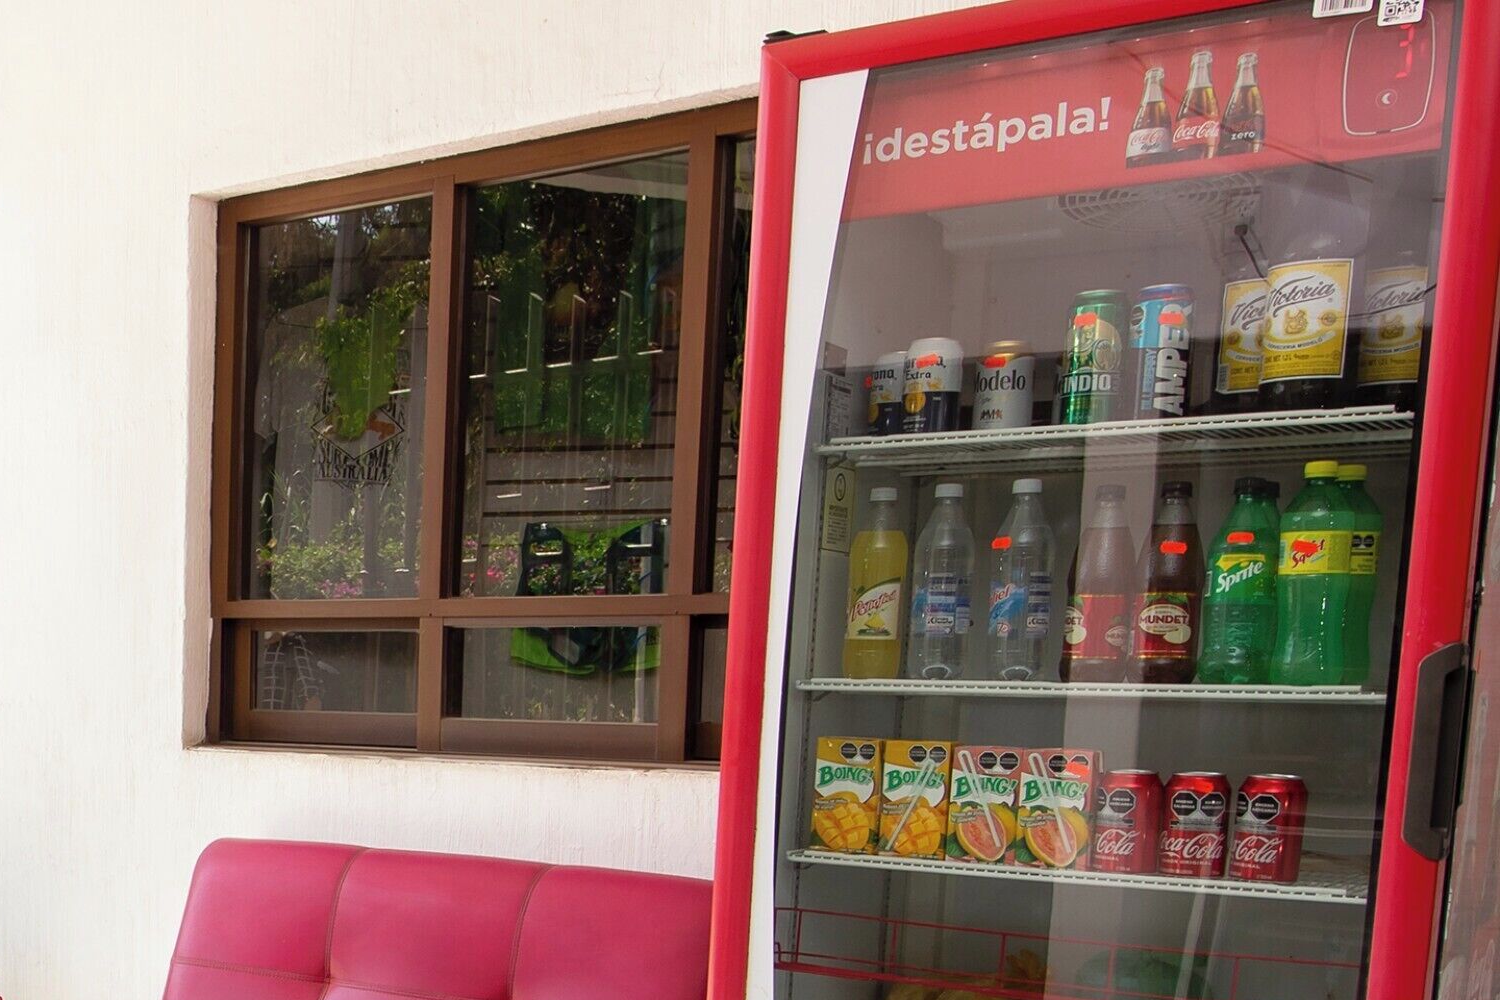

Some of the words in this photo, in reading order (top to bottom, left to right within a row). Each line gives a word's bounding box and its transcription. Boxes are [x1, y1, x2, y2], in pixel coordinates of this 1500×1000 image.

[863, 97, 1112, 165] ¡destápala!
[1231, 131, 1255, 141] zero
[1267, 274, 1336, 318] Victoria
[1064, 374, 1112, 394] INDIO
[1215, 562, 1264, 594] Sprite
[1140, 614, 1187, 624] MUNDET
[817, 765, 875, 789] BOING!
